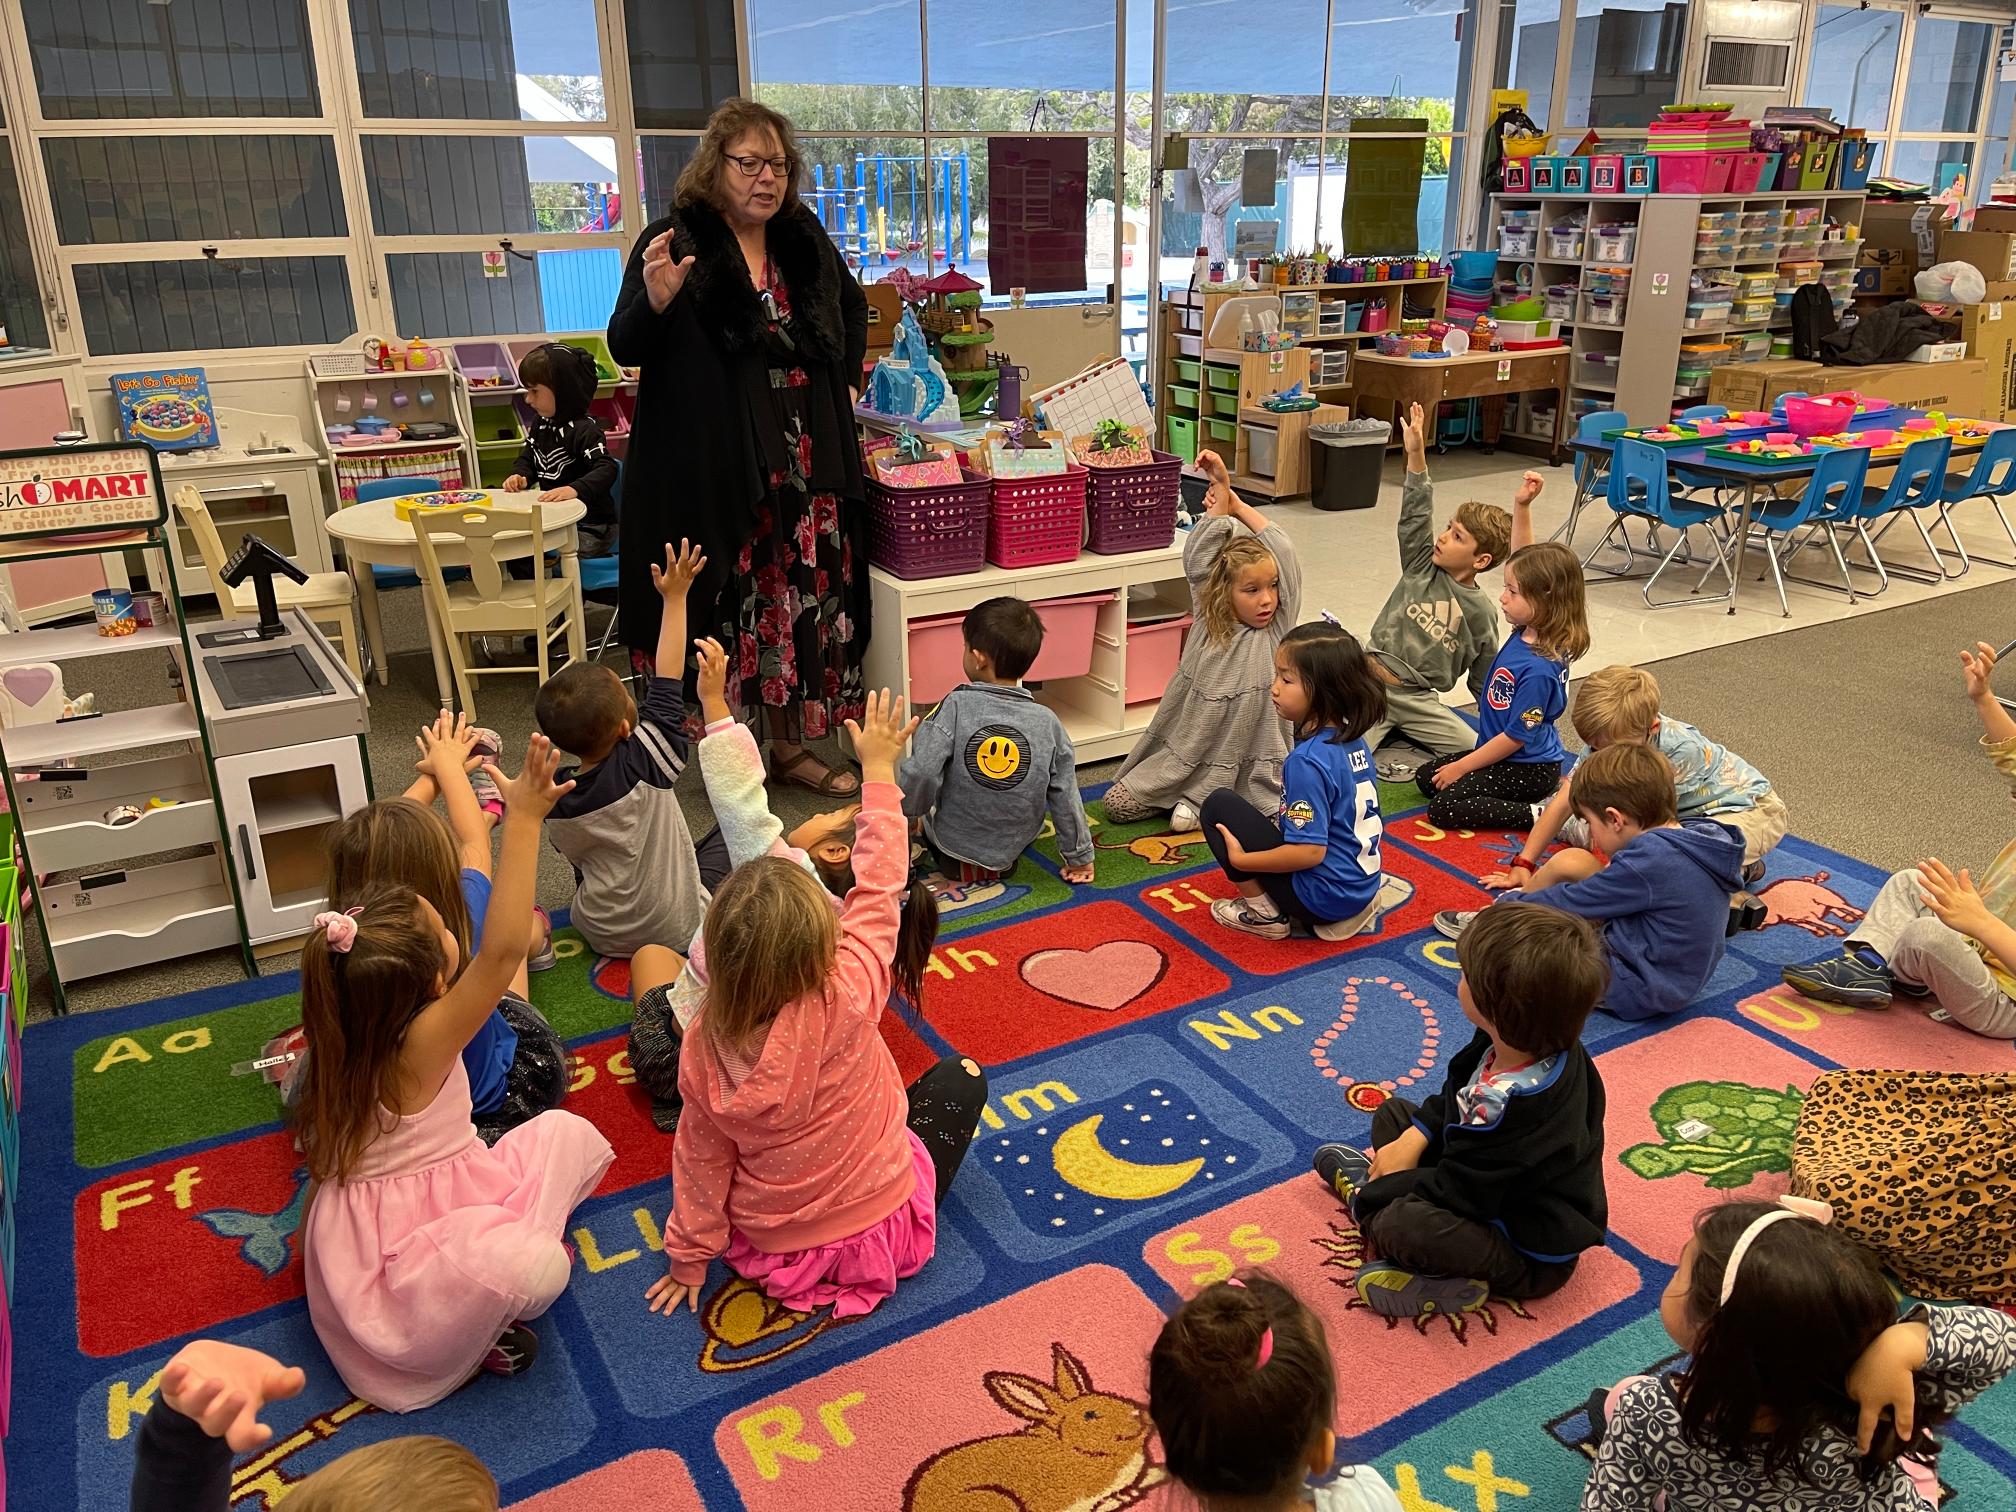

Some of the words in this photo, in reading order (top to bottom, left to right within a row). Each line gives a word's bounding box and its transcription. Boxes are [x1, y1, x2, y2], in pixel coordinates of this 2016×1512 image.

[1511, 169, 1520, 182] A
[1538, 170, 1548, 183] A
[1568, 169, 1577, 182] A
[1601, 169, 1608, 182] B
[1635, 168, 1642, 182] B
[117, 377, 141, 392] Let's
[143, 375, 160, 389] Go
[50, 454, 96, 467] Dairy
[110, 451, 143, 462] Deli
[8, 464, 72, 481] Frozen
[78, 461, 134, 474] Foods
[52, 473, 148, 503] MART
[12, 516, 76, 531] Bakery
[93, 510, 154, 523] Snacks
[19, 505, 83, 520] Canned
[89, 499, 144, 513] Goods
[1406, 603, 1460, 653] adidas
[1348, 749, 1370, 773] LEE
[1354, 780, 1384, 876] 6
[1149, 882, 1225, 914] Ii
[1187, 1005, 1305, 1051] Nn
[93, 1026, 213, 1073] Aa
[100, 1165, 203, 1232] Ff
[1165, 1222, 1281, 1287] Ss
[735, 1391, 867, 1481] Rr
